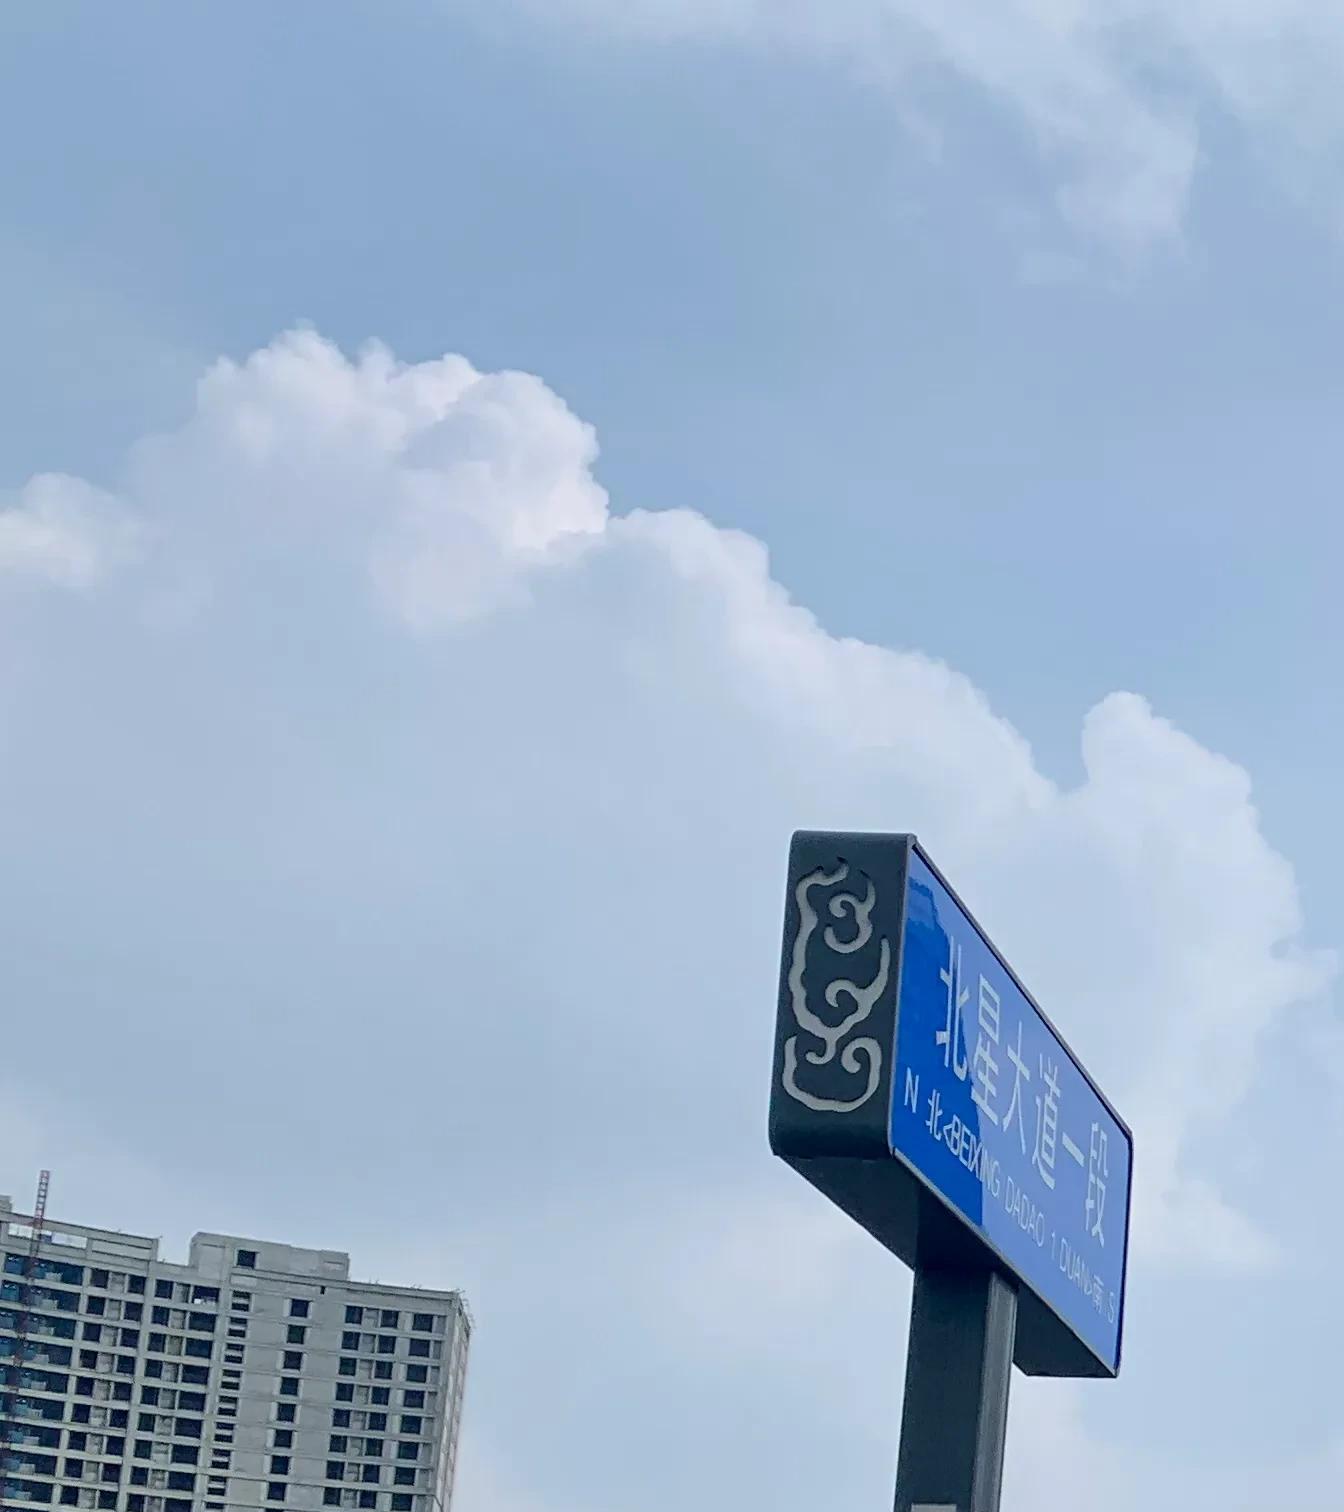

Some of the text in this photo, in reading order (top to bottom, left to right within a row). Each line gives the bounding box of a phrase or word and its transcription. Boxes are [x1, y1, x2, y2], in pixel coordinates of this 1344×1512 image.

[904, 1067, 919, 1113] N
[925, 1089, 942, 1141] 北
[949, 1115, 1000, 1199] BEIXING
[1005, 1175, 1045, 1247] DADAO
[936, 933, 1108, 1248] 北星大道一段
